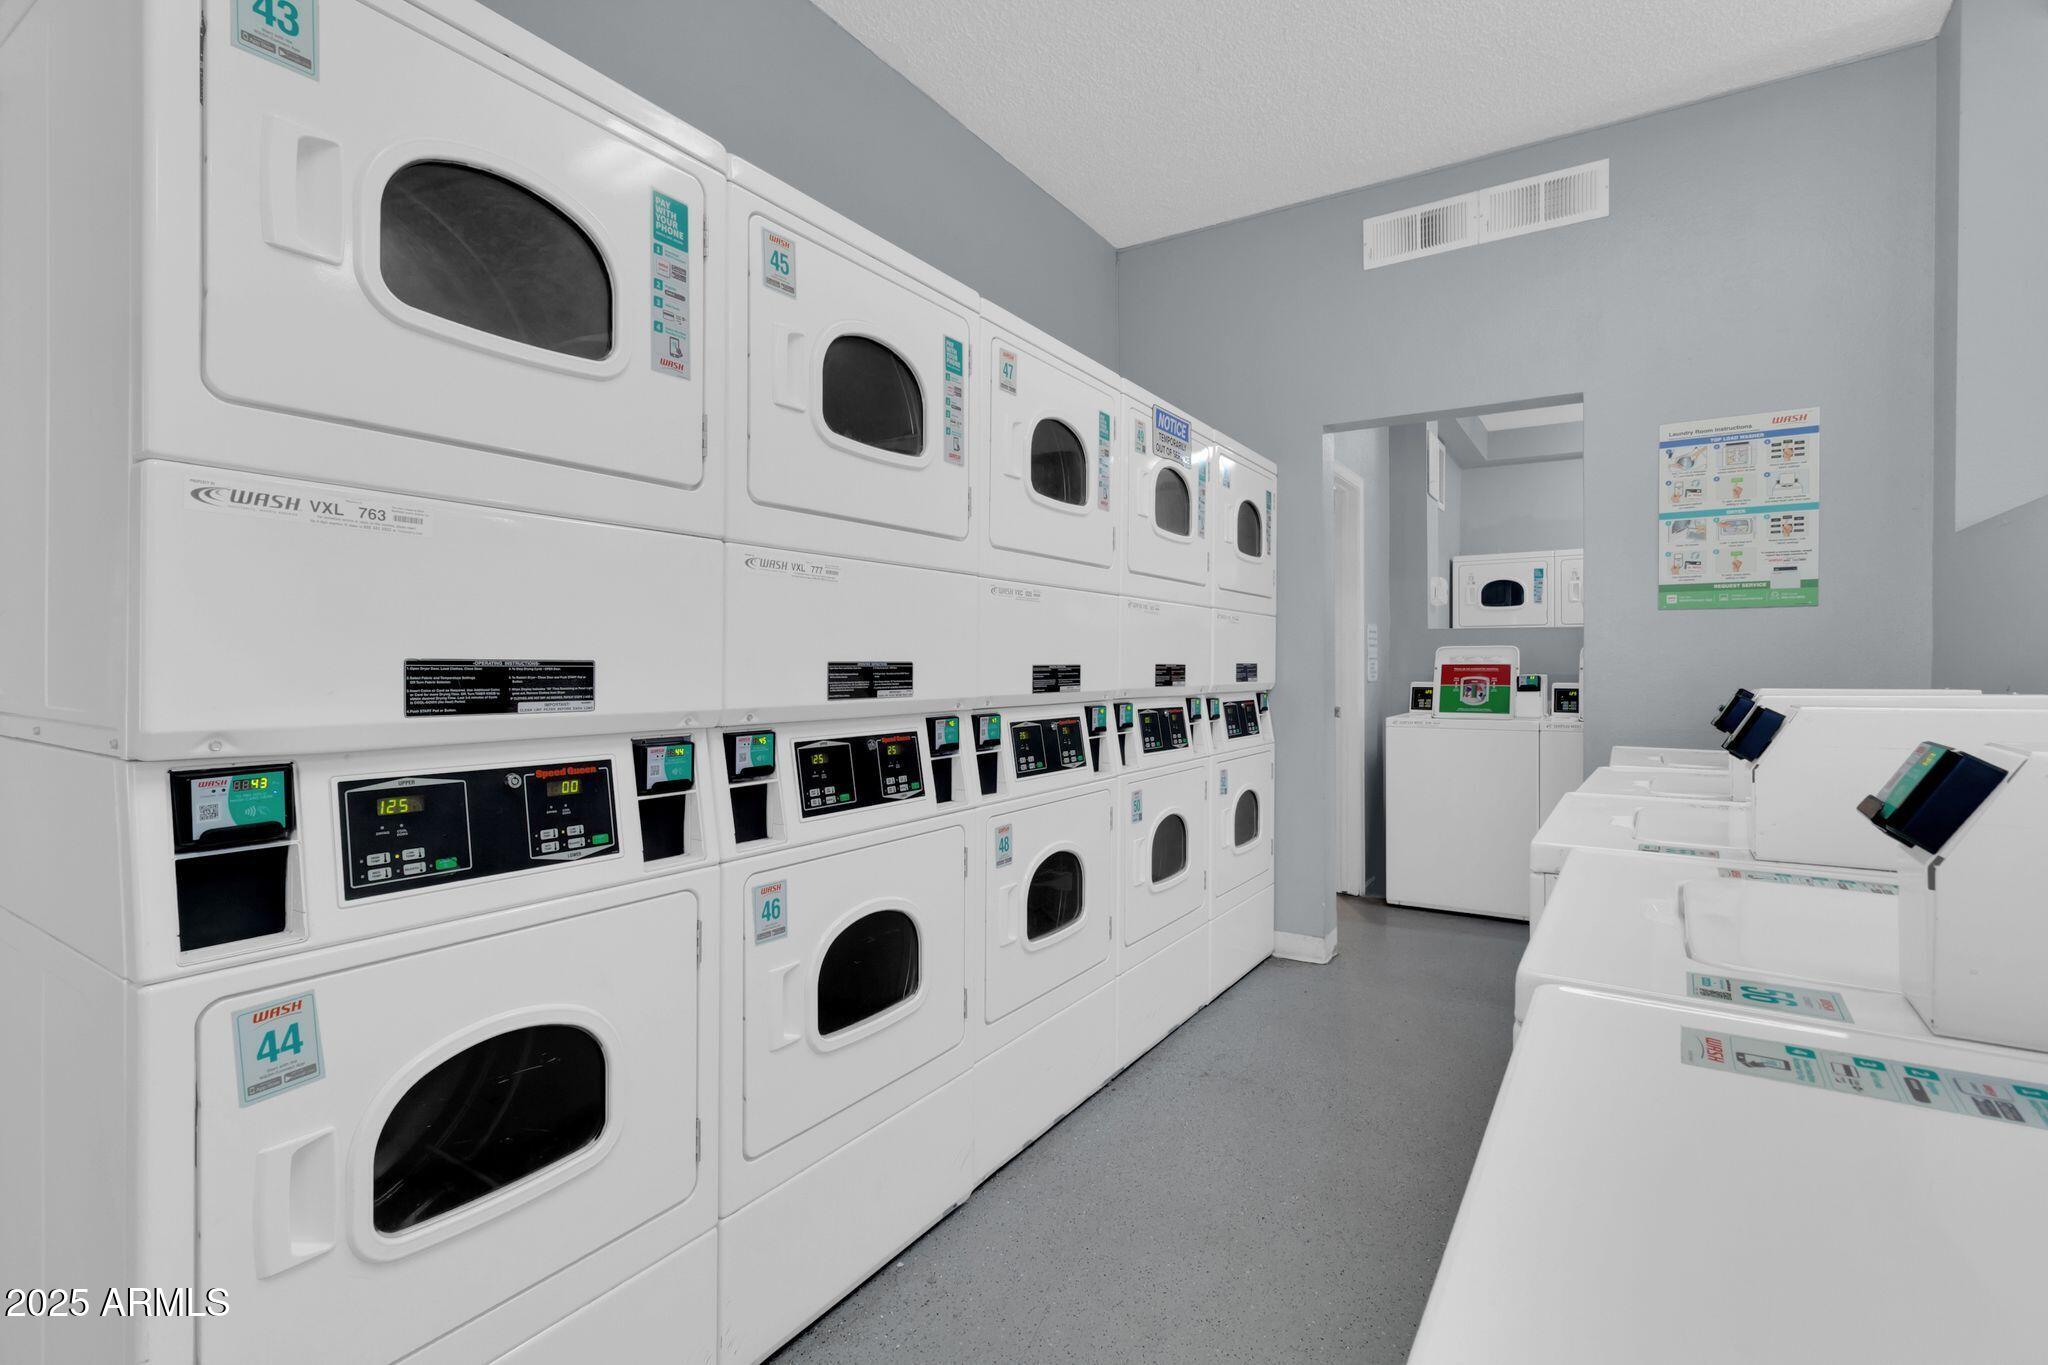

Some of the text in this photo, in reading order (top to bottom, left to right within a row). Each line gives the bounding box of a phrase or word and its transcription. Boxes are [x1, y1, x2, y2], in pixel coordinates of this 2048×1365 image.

[252, 0, 300, 37] 43
[655, 196, 671, 209] PAY
[655, 204, 677, 220] WITH
[656, 212, 678, 229] YOUR
[655, 221, 684, 240] PHONE
[770, 250, 790, 276] 45
[660, 357, 684, 371] WASH
[1003, 362, 1013, 380] 47
[1158, 412, 1187, 439] NOTICE
[1772, 413, 1808, 425] WASH
[1668, 430, 1694, 438] Laundry
[1714, 423, 1753, 433] Instructions
[229, 484, 301, 511] WASH
[310, 500, 344, 516] VXL
[359, 507, 386, 521] 763
[759, 558, 823, 574] WASH VXL 777
[887, 745, 897, 755] 25
[812, 754, 824, 765] 25
[535, 766, 597, 779] Speed Queen
[198, 780, 228, 788] WASH
[250, 777, 268, 789] 43
[562, 780, 579, 794] 00
[380, 798, 409, 815] 125
[999, 836, 1010, 853] 48
[761, 898, 781, 921] 46
[252, 1000, 303, 1024] WASH
[256, 1022, 304, 1063] 44
[1705, 1037, 1725, 1064] WASH
